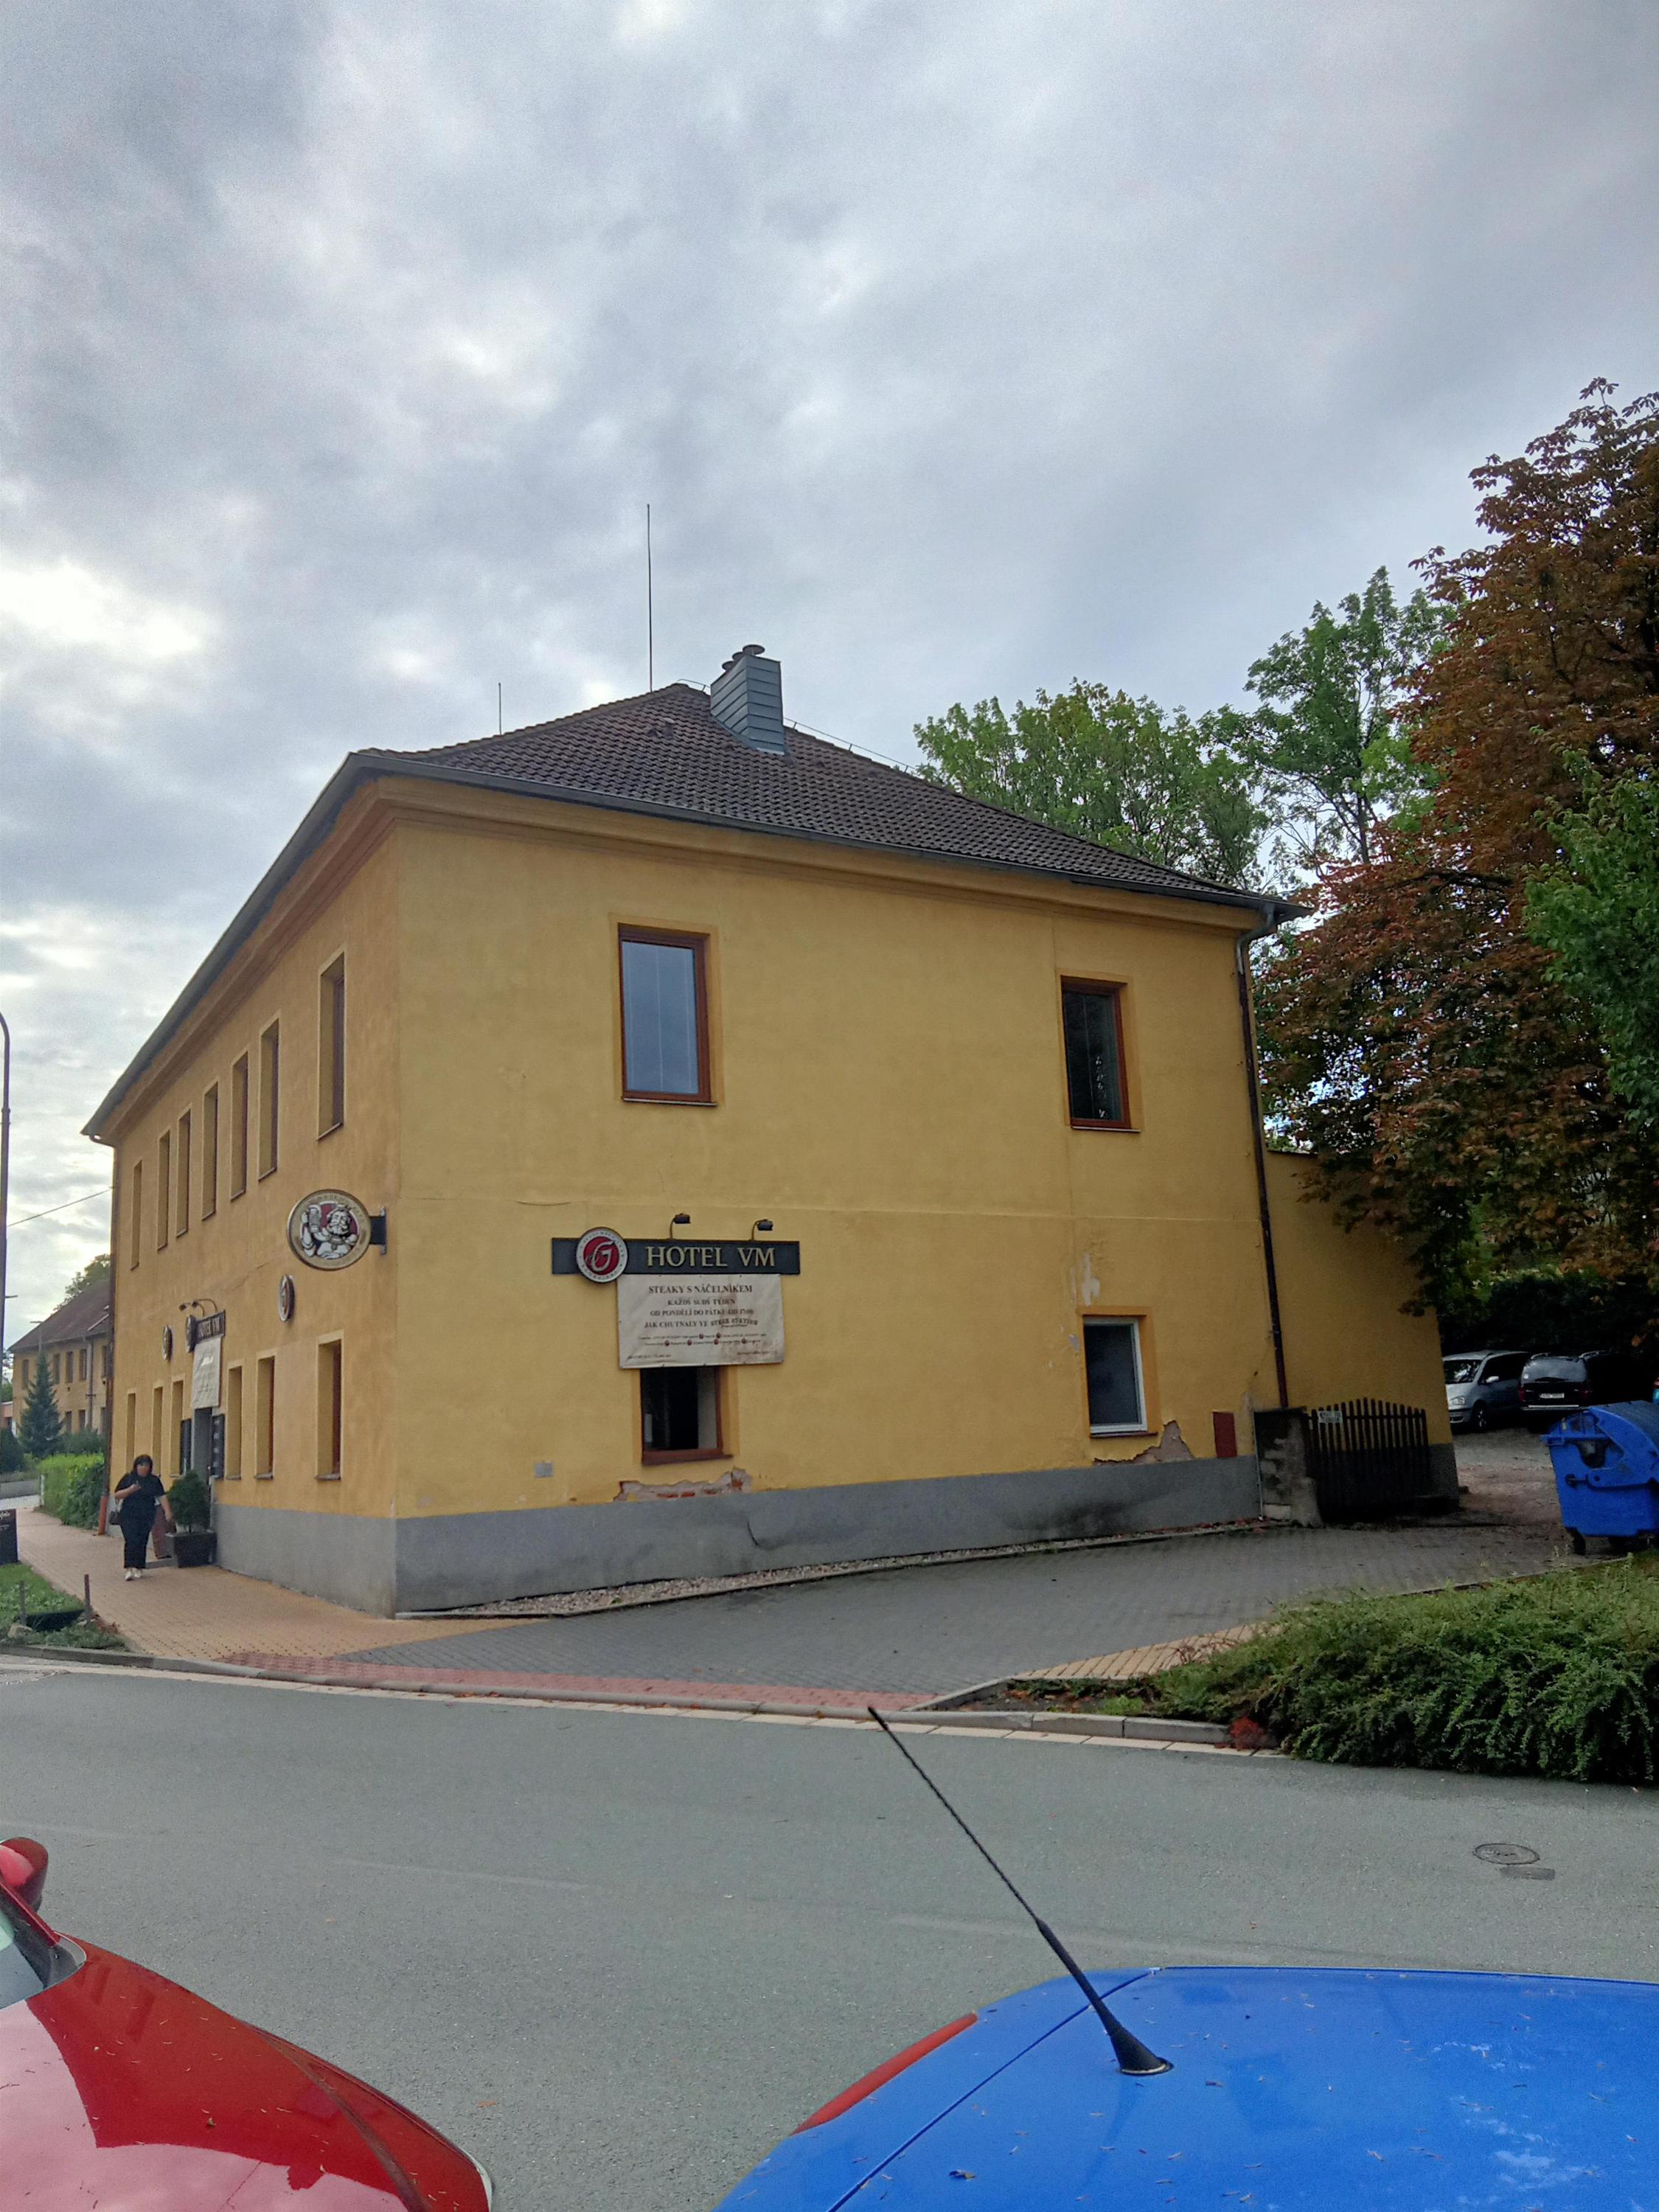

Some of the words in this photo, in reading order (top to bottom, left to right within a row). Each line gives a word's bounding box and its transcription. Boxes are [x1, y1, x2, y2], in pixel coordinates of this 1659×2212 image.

[645, 1246, 728, 1267] HOTEL
[737, 1248, 776, 1267] VM
[648, 1285, 684, 1293] STEAKY
[695, 1284, 753, 1293] NÁČELNÍKEM
[667, 1298, 691, 1306] KAŽDÝ
[714, 1297, 736, 1305] TÝDEN
